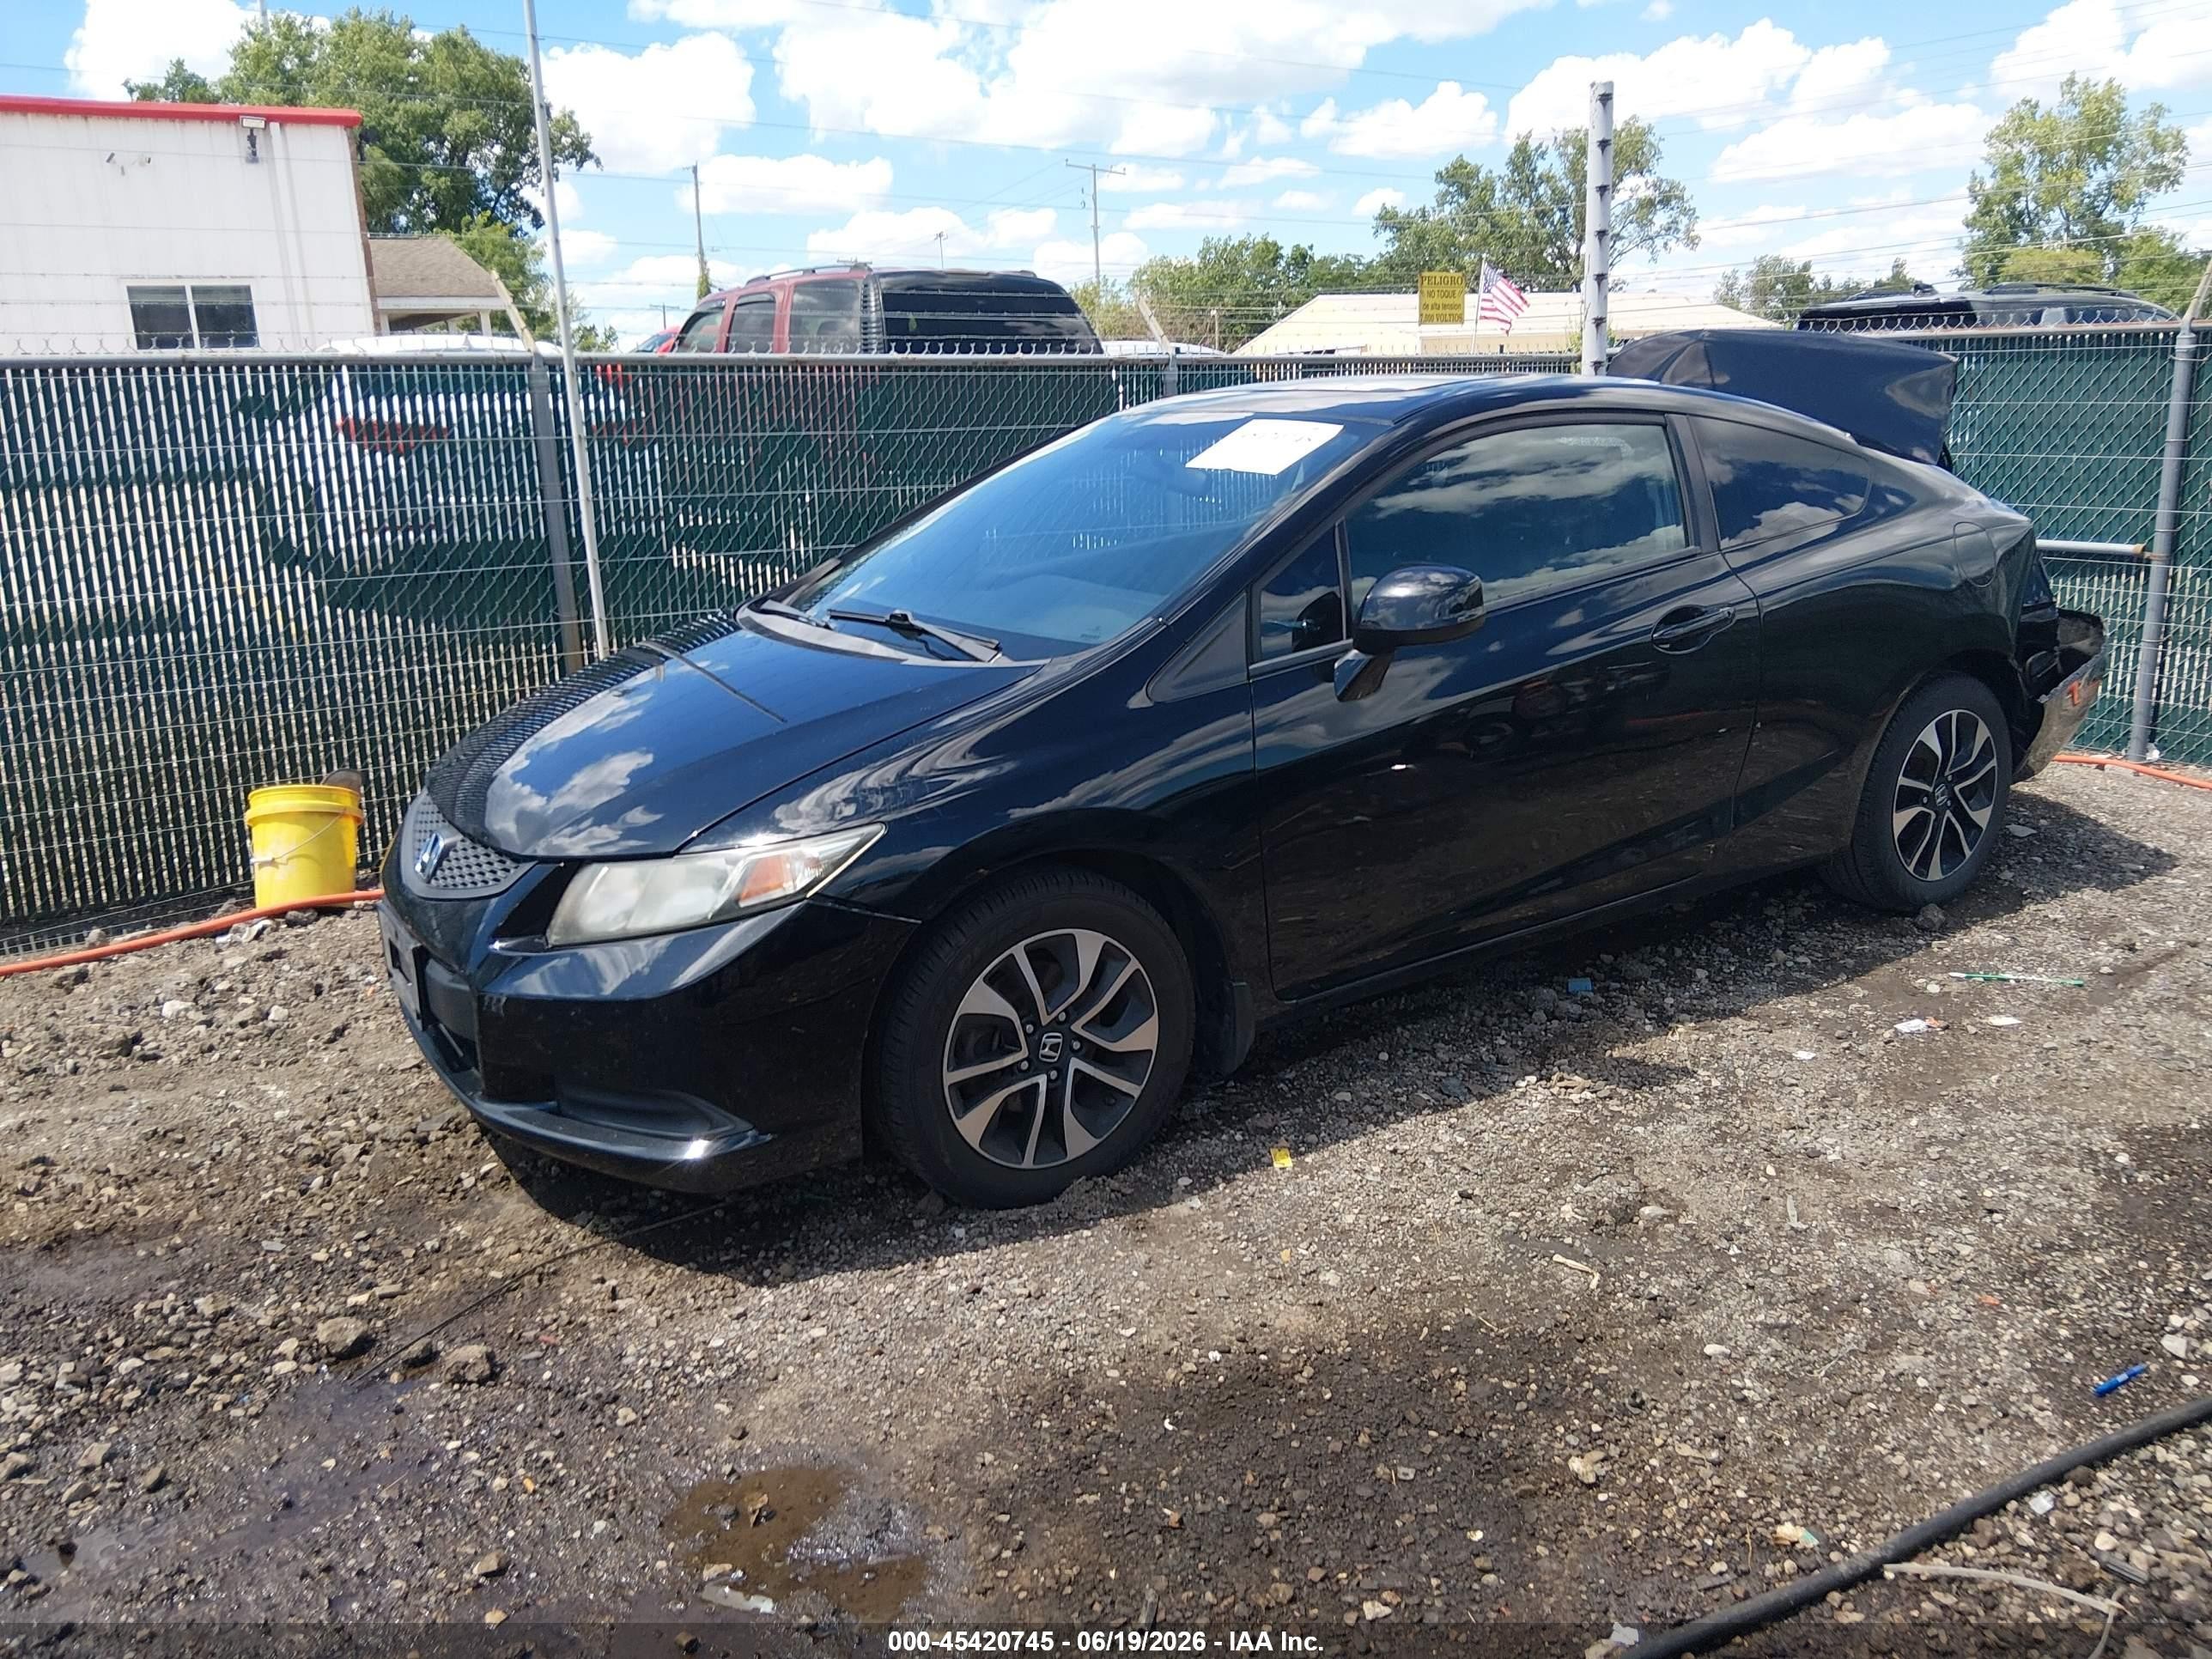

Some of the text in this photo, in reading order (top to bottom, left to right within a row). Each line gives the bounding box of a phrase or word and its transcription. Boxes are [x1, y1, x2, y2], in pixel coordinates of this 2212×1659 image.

[1421, 276, 1463, 286] PELIGRO
[1427, 289, 1456, 299] NO TOQUE
[1436, 313, 1463, 322] VOLTIOS
